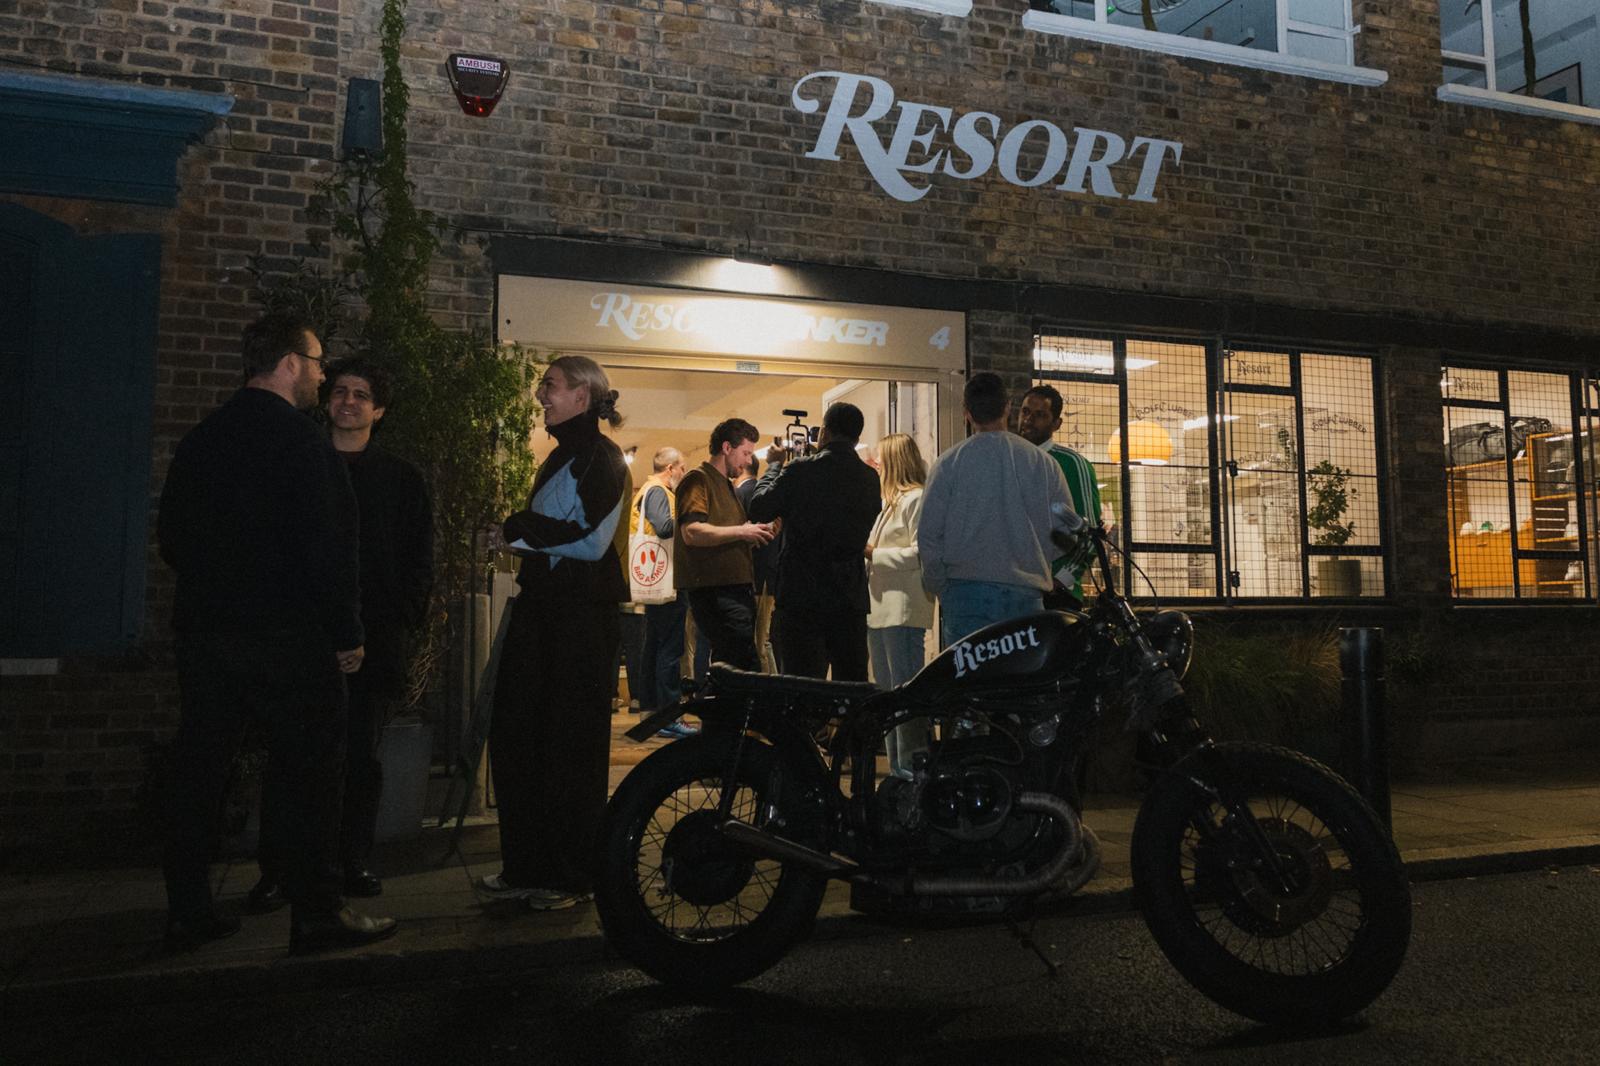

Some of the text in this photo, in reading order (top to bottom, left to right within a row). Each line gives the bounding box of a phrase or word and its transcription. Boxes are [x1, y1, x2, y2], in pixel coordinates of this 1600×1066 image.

[459, 59, 499, 70] AMBUSH
[792, 71, 1183, 203] RESORT
[929, 327, 950, 351] 4
[634, 565, 645, 581] BAG
[650, 560, 665, 581] SMILE
[953, 626, 1040, 679] Resort
